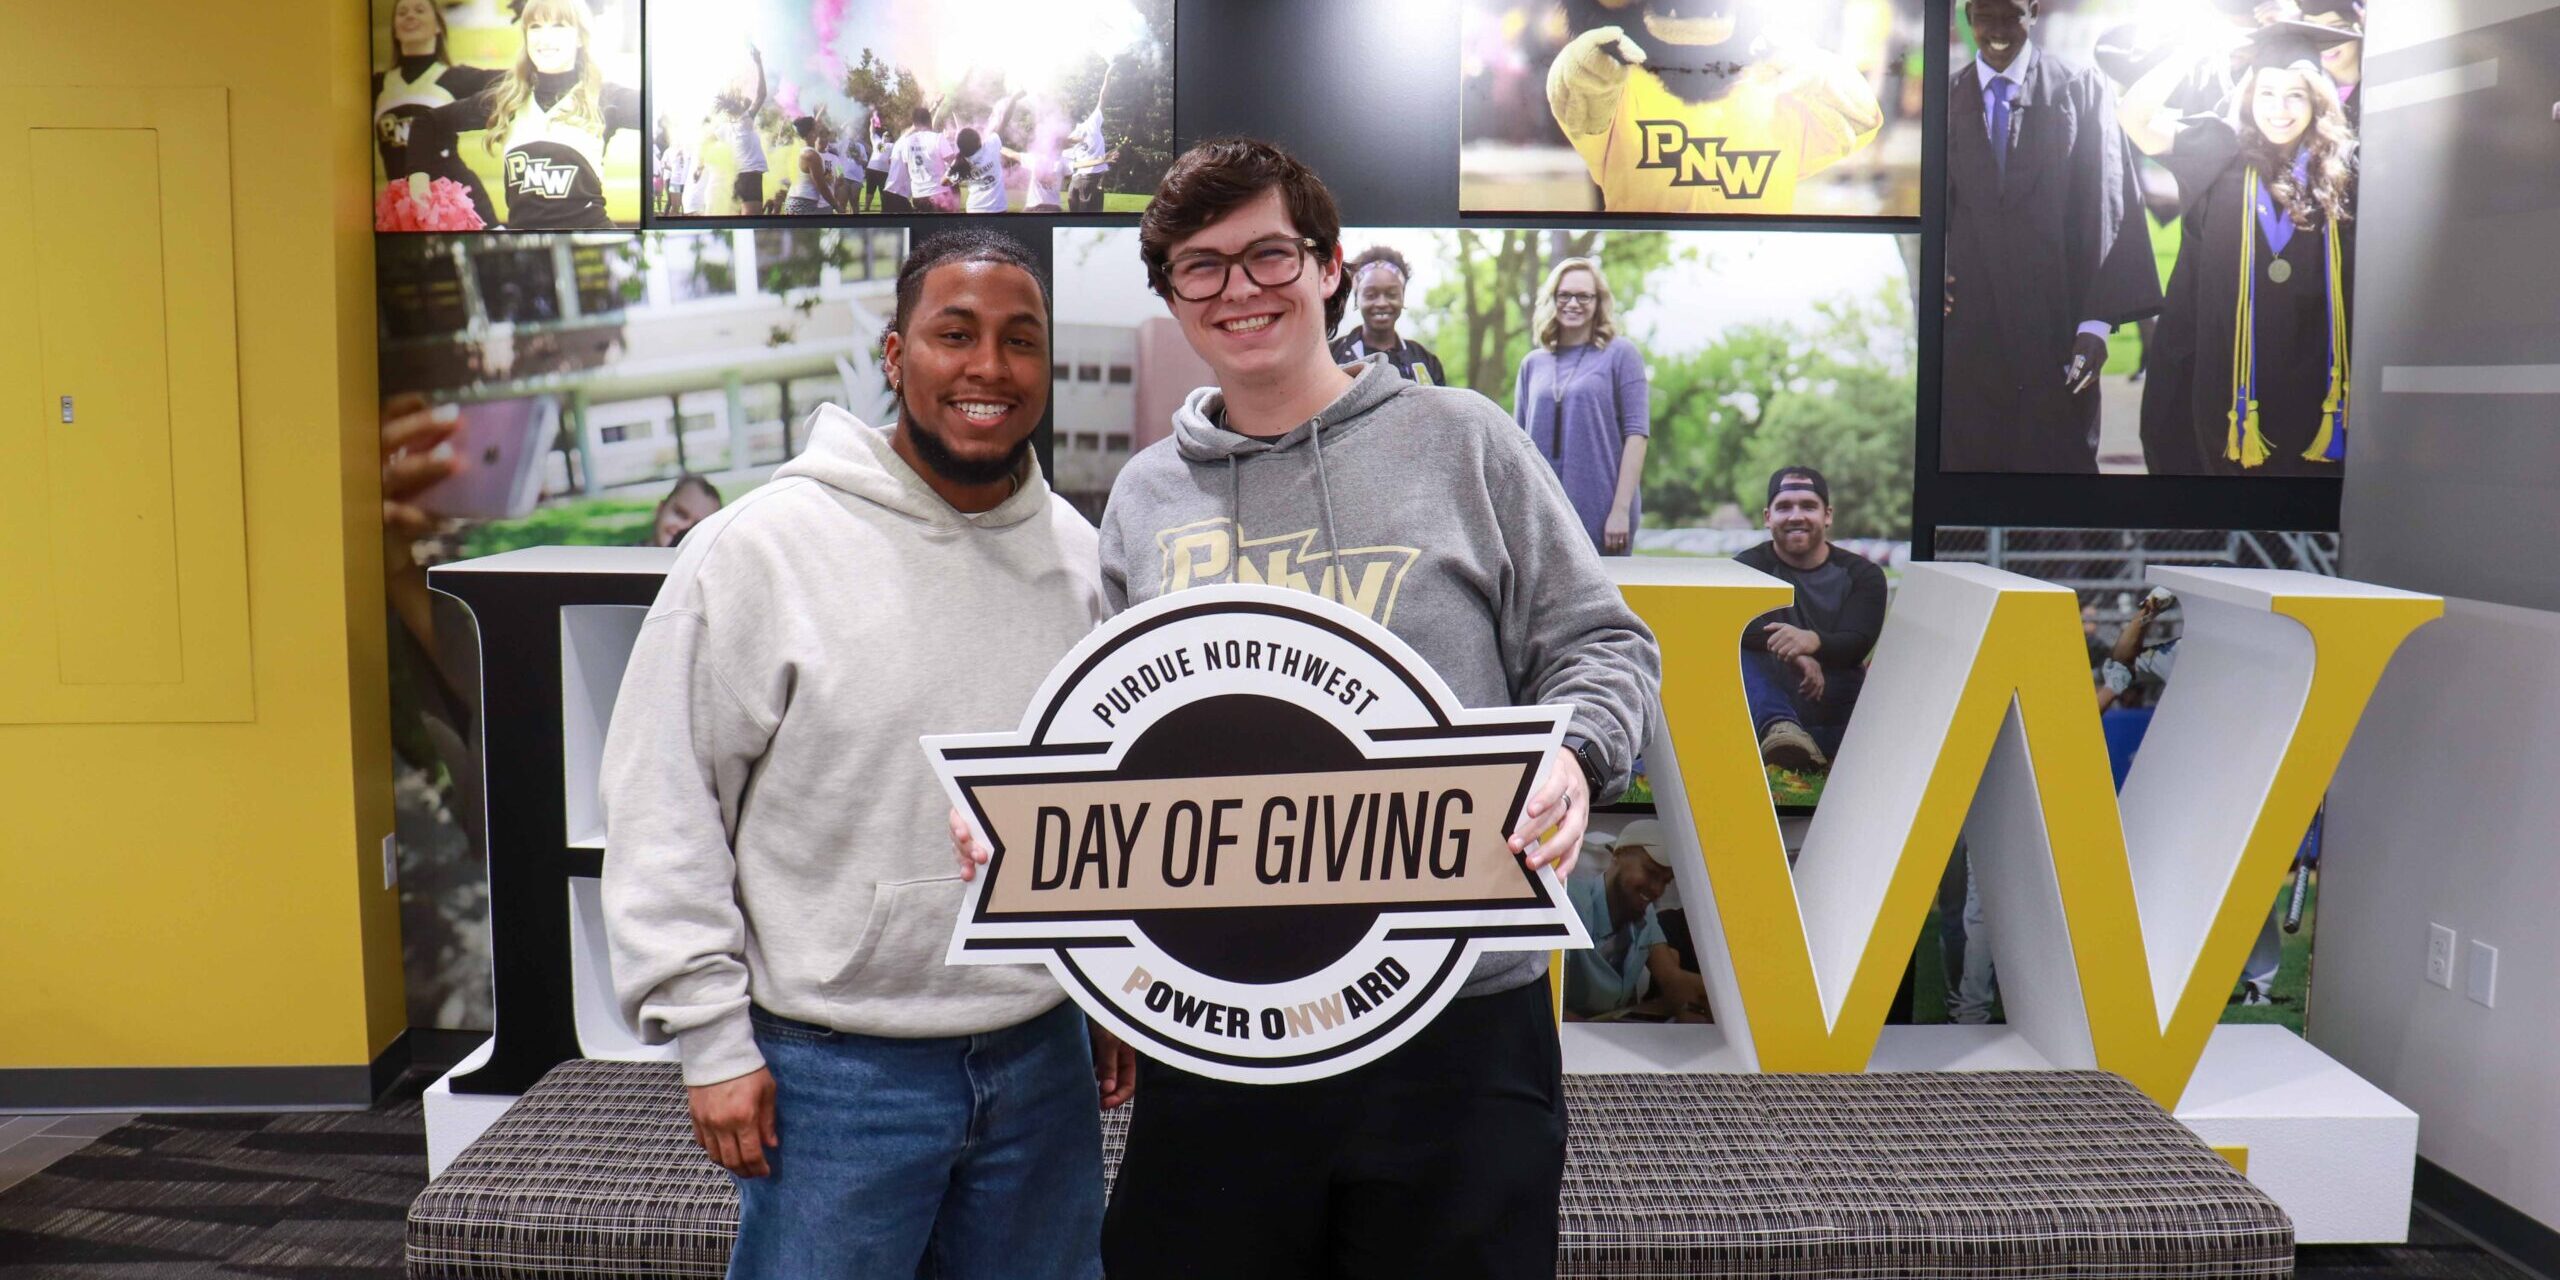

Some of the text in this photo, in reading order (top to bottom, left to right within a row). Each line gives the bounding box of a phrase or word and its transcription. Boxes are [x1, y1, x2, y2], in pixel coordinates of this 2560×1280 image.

[506, 152, 577, 198] PNW
[1636, 120, 1780, 198] PNW
[1092, 640, 1379, 728] PURDUE NORTHWEST
[1031, 788, 1474, 891] DAY OF GIVING
[1121, 956, 1410, 1041] POWER ONWARD
